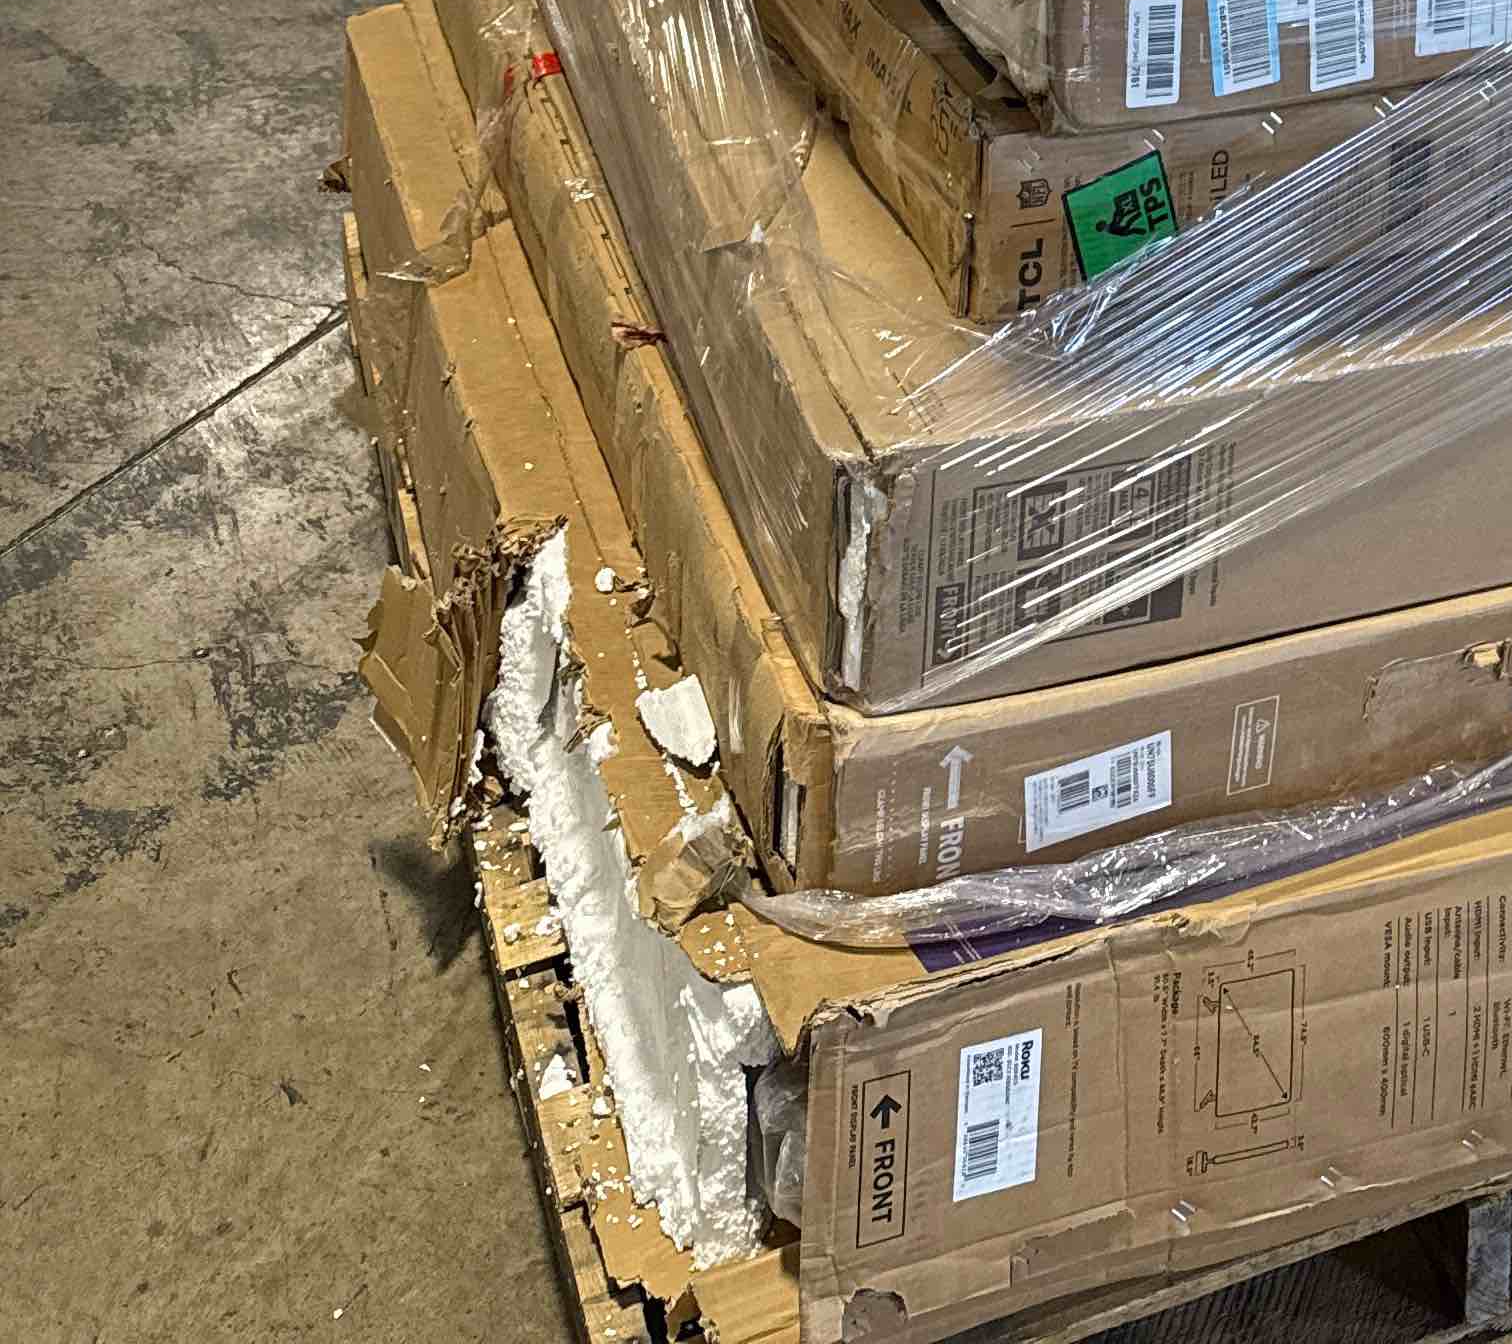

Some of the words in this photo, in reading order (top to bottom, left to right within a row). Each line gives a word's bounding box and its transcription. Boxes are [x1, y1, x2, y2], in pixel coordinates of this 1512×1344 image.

[1210, 149, 1230, 191] LED
[1146, 176, 1167, 234] TPS
[1017, 237, 1045, 312] TCL
[935, 815, 965, 881] FRON
[1384, 922, 1392, 950] VESA
[1404, 917, 1412, 947] Audio
[1424, 913, 1432, 933] USB
[1498, 896, 1507, 963] Connectivity:
[1452, 906, 1463, 979] Antenna/cable
[1383, 953, 1391, 988] mount:
[1402, 950, 1411, 986] output:
[1171, 972, 1182, 1014] Package
[1399, 1029, 1409, 1061] digital
[1422, 1025, 1430, 1056] USB-C
[1472, 1015, 1480, 1040] HDMI
[1399, 1064, 1408, 1096] optical
[871, 1140, 896, 1223] FRONT
